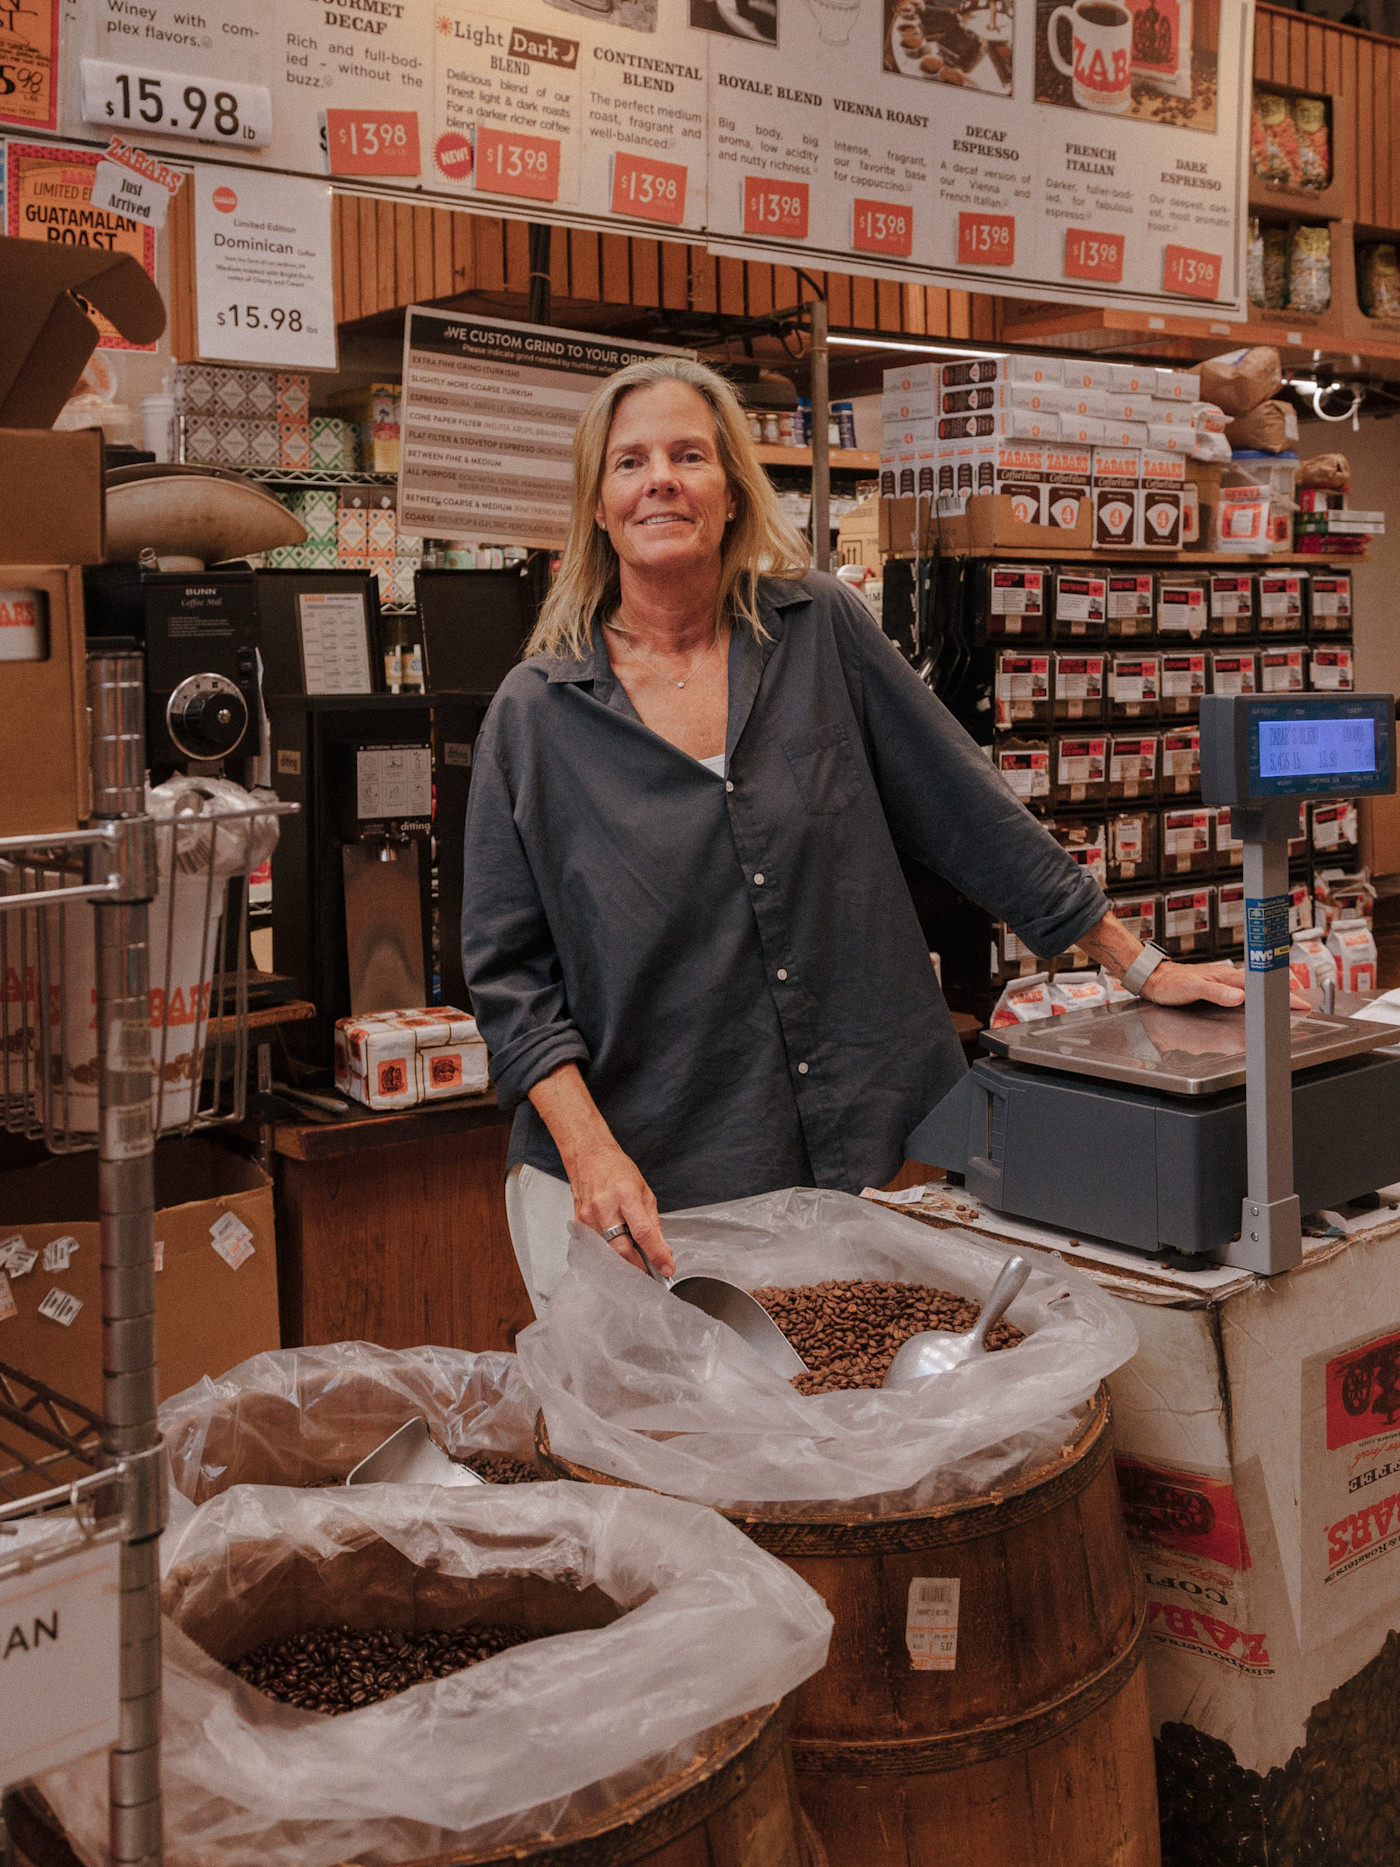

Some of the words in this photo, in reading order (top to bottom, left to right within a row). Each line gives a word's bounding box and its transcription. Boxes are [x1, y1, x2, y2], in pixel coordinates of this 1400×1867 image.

[109, 0, 157, 19] Winey
[174, 14, 206, 28] with
[222, 22, 259, 37] com-
[324, 11, 387, 35] DECAF
[107, 20, 139, 35] plex
[146, 24, 200, 47] flavors.
[454, 21, 504, 48] Light
[512, 34, 559, 60] Dark
[286, 34, 317, 50] Rich
[329, 41, 354, 56] and
[365, 49, 422, 68] full-bod-
[286, 53, 308, 67] ied
[339, 62, 390, 82] without
[402, 72, 422, 88] the
[490, 56, 530, 76] BLEND
[593, 47, 702, 81] CONTINENTAL
[286, 70, 323, 88] buzz.
[447, 69, 491, 87] Delicious
[500, 78, 528, 94] blend
[537, 84, 546, 97] of
[554, 90, 571, 102] our
[623, 73, 674, 93] BLEND
[447, 84, 474, 100] finest
[479, 91, 500, 104] light
[506, 96, 512, 105] &
[517, 98, 538, 112] dark
[542, 104, 570, 118] roasts
[718, 74, 772, 95] ROYALE
[777, 86, 822, 107] BLEND
[106, 74, 239, 136] $15.98
[243, 125, 255, 139] lb
[446, 100, 464, 113] For
[476, 108, 506, 121] darker
[510, 114, 537, 128] richer
[540, 119, 570, 133] coffee
[590, 92, 610, 105] The
[614, 97, 654, 115] perfect
[658, 104, 701, 123] medium
[834, 98, 882, 119] VIENNA
[887, 109, 929, 127] ROAST
[629, 116, 673, 134] fragrant
[681, 128, 701, 139] and
[718, 117, 735, 131] Big
[756, 125, 782, 140] body,
[803, 135, 818, 147] big
[966, 126, 1007, 142] DECAF
[441, 147, 469, 166] NEW!
[718, 135, 751, 149] aroma,
[760, 141, 778, 153] low
[785, 147, 818, 162] acidity
[834, 141, 871, 157] Intense,
[887, 150, 926, 168] fragrant,
[952, 140, 1019, 160] ESPRESSO
[1066, 143, 1116, 160] FRENCH
[718, 151, 737, 161] and
[740, 155, 767, 169] nutty
[834, 158, 850, 167] our
[860, 161, 895, 175] favorite
[905, 168, 926, 180] base
[1066, 160, 1114, 176] ITALIAN
[1176, 160, 1208, 173] DARK
[834, 171, 848, 181] for
[940, 161, 947, 169] A
[953, 164, 978, 175] decaf
[984, 169, 1016, 182] version
[1022, 175, 1031, 184] of
[1161, 173, 1222, 191] ESPRESSO
[33, 183, 78, 200] LIMITED
[120, 179, 143, 196] Just
[940, 176, 955, 186] our
[969, 181, 1000, 194] Vienna
[1014, 188, 1030, 198] and
[940, 190, 971, 203] French
[109, 194, 150, 218] Arrived
[1149, 194, 1164, 204] Our
[26, 204, 136, 233] GUATAMALAN
[234, 219, 265, 231] Limited
[268, 222, 296, 233] Edition
[214, 233, 293, 254] Dominican
[217, 304, 302, 332] $15.98
[306, 326, 318, 335] lbs
[447, 325, 467, 340] WE
[469, 330, 521, 349] CUSTOM
[525, 339, 565, 356] GRIND
[568, 344, 583, 357] TO
[585, 347, 617, 363] YOUR
[412, 356, 436, 366] EXTRA
[438, 360, 454, 368] FINE
[457, 363, 480, 372] GRIND
[411, 375, 444, 387] SLIGHTLY
[447, 380, 468, 390] MORE
[471, 383, 500, 393] COARSE
[503, 387, 533, 398] TURKISH
[410, 393, 447, 405] ESPRESSO
[410, 413, 430, 422] CONE
[433, 415, 456, 425] PAPER
[458, 419, 482, 428] FILTER
[409, 432, 427, 441] FLAT
[428, 434, 451, 445] FILTER
[460, 438, 498, 450] STOVETOP
[499, 442, 535, 453] ESPRESSO
[408, 450, 444, 461] BETWEEN
[445, 454, 462, 463] FINE
[471, 457, 501, 467] MEDIUM
[407, 468, 420, 477] ALL
[422, 470, 456, 480] PURPOSE
[443, 498, 473, 507] COARSE
[482, 503, 512, 511] MEDIUM
[405, 512, 435, 521] COARSE
[181, 599, 204, 608] Coffee
[400, 821, 430, 832] ditting
[1251, 950, 1273, 961] NYC
[1336, 1544, 1387, 1575] Roasters
[1169, 1640, 1261, 1675] Importers
